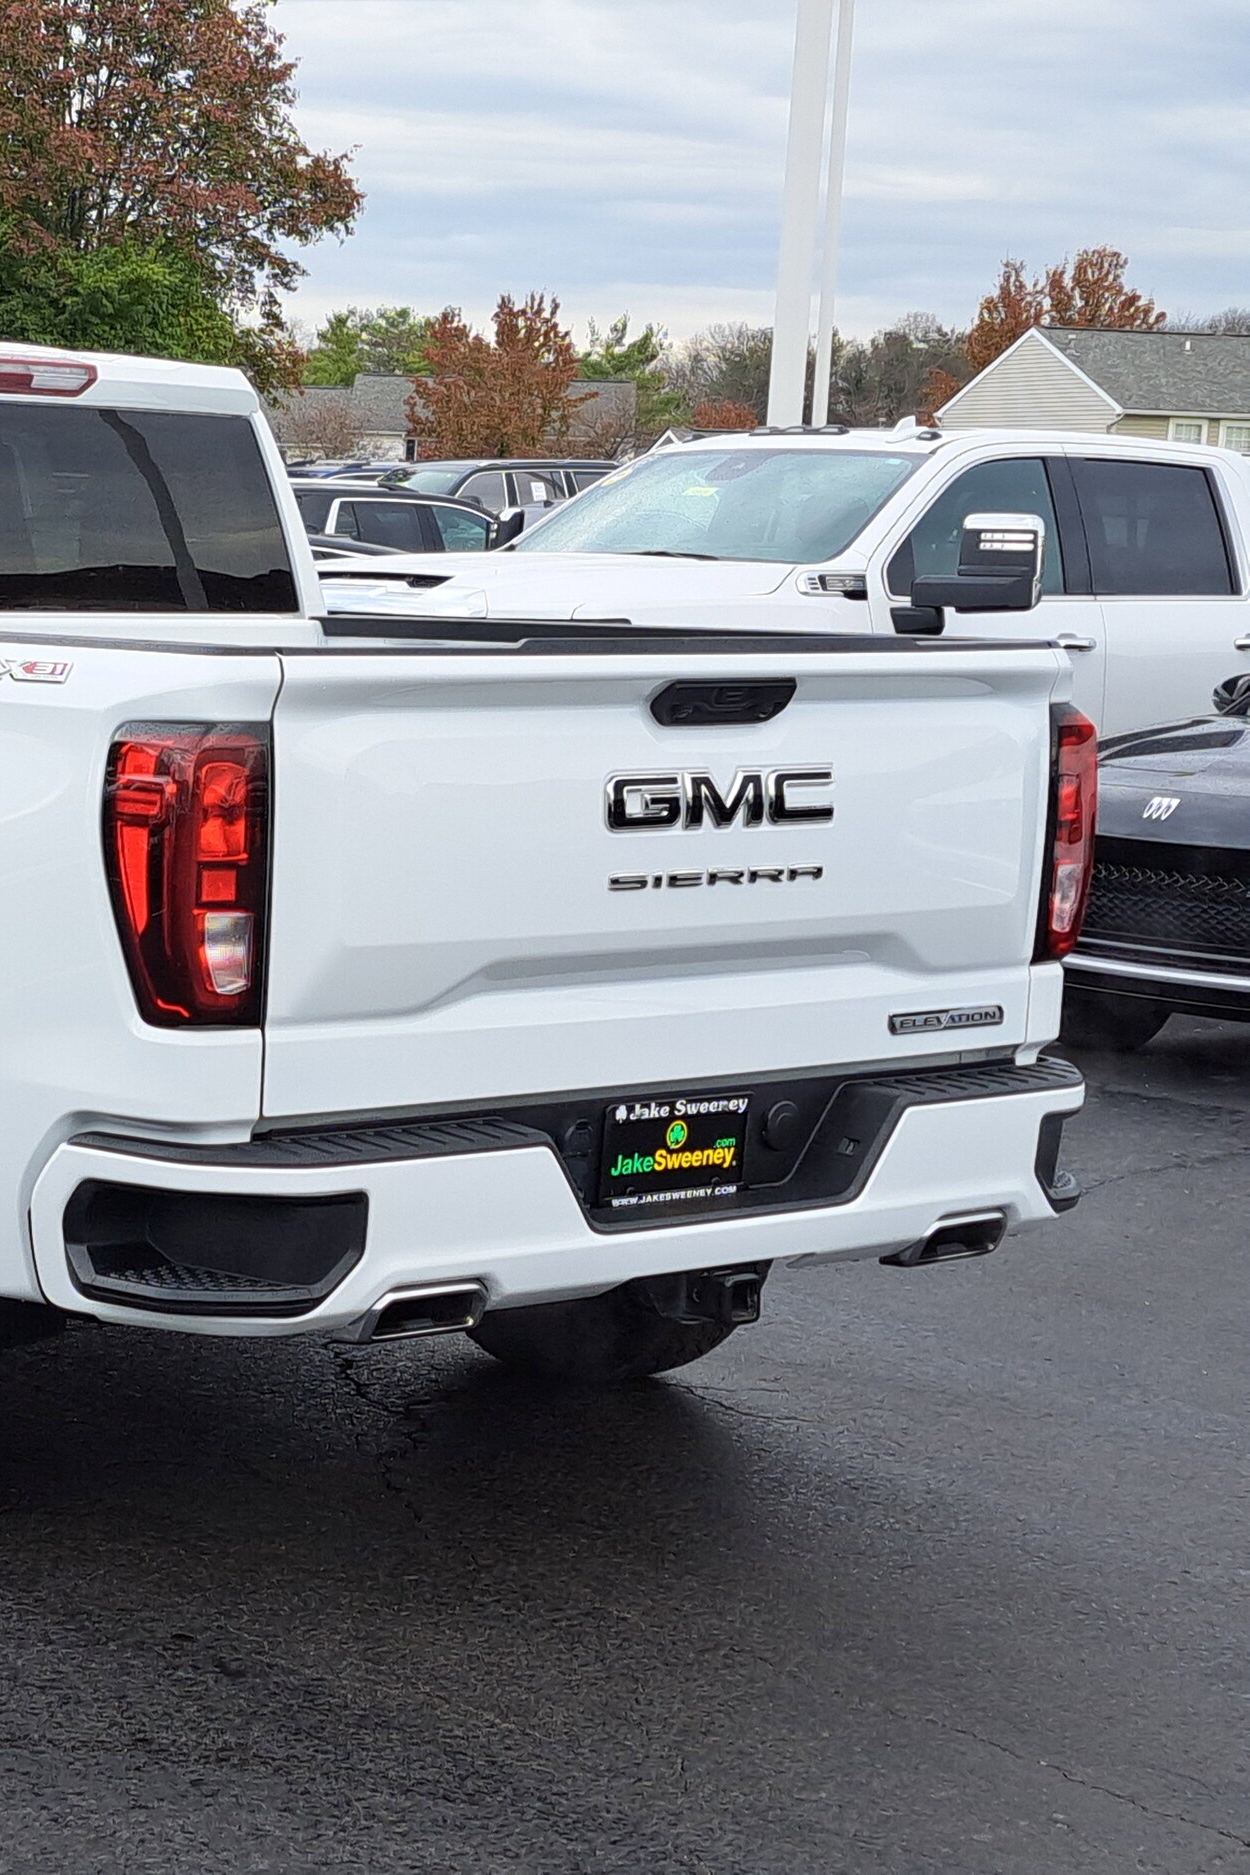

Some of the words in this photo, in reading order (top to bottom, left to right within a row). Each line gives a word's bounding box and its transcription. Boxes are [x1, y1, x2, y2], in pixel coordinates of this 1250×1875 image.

[606, 764, 834, 832] GMC
[608, 863, 824, 891] SIERRA
[900, 1010, 997, 1029] ELEVATION
[629, 1103, 670, 1120] Jake
[674, 1098, 748, 1116] Sweeney
